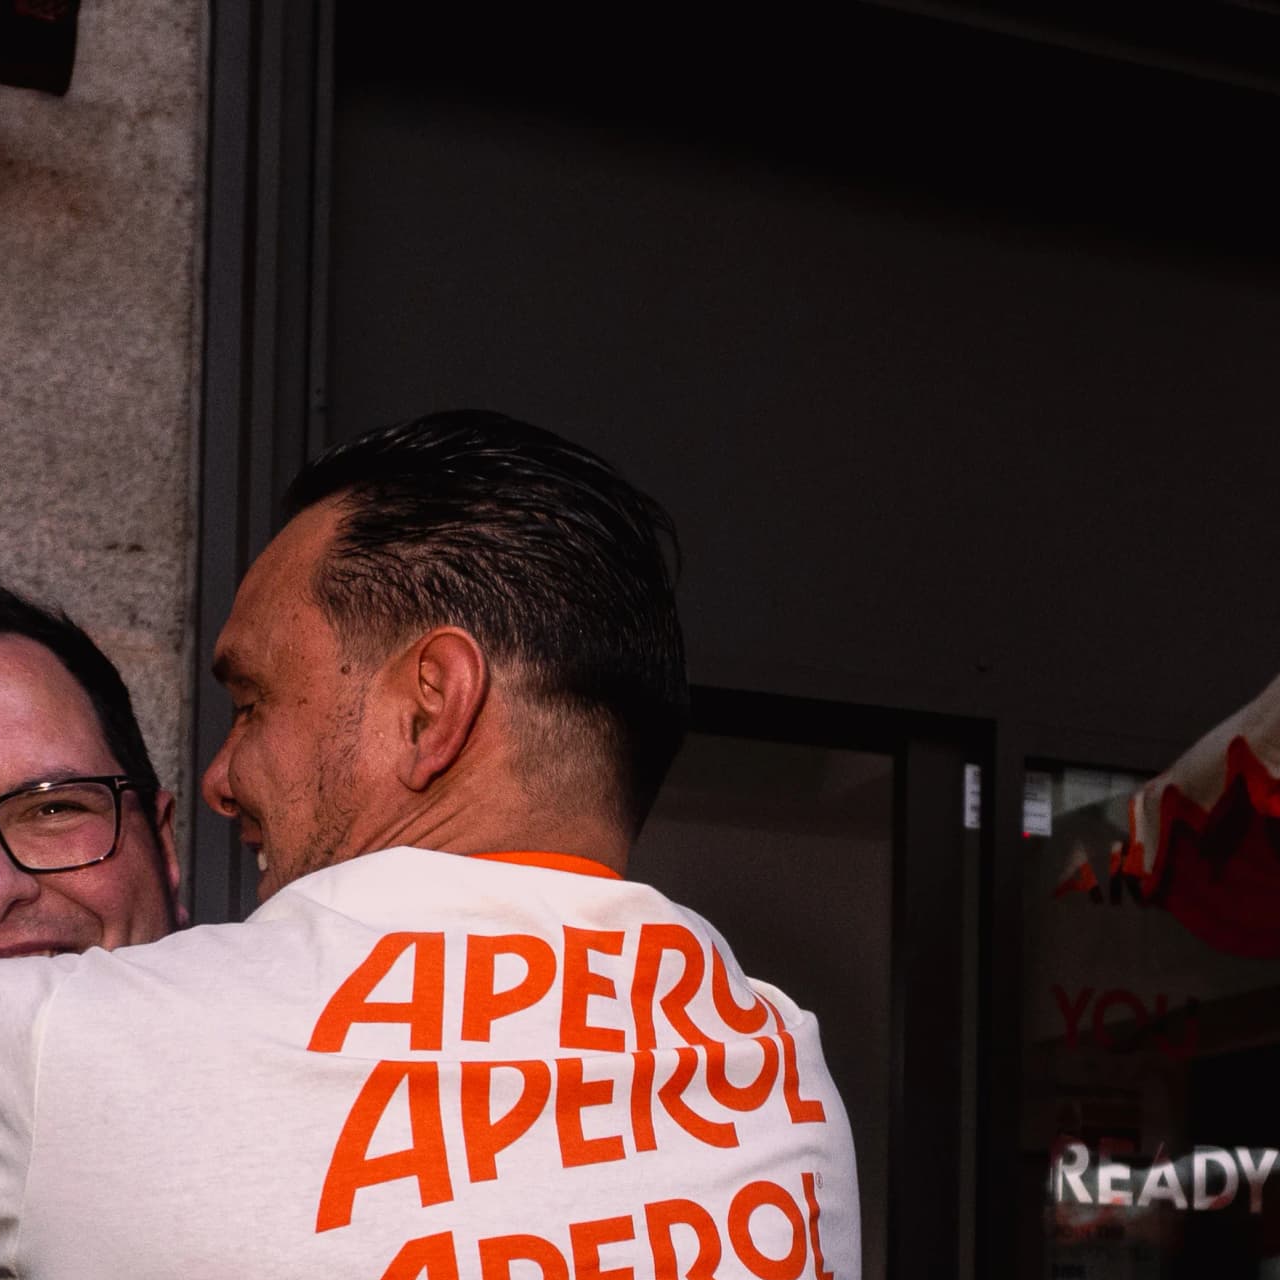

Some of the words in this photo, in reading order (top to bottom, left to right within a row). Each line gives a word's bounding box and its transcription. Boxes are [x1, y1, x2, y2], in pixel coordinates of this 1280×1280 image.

[1051, 984, 1200, 1059] YOU
[315, 1030, 827, 1235] APEROL
[1051, 1141, 1279, 1215] READY
